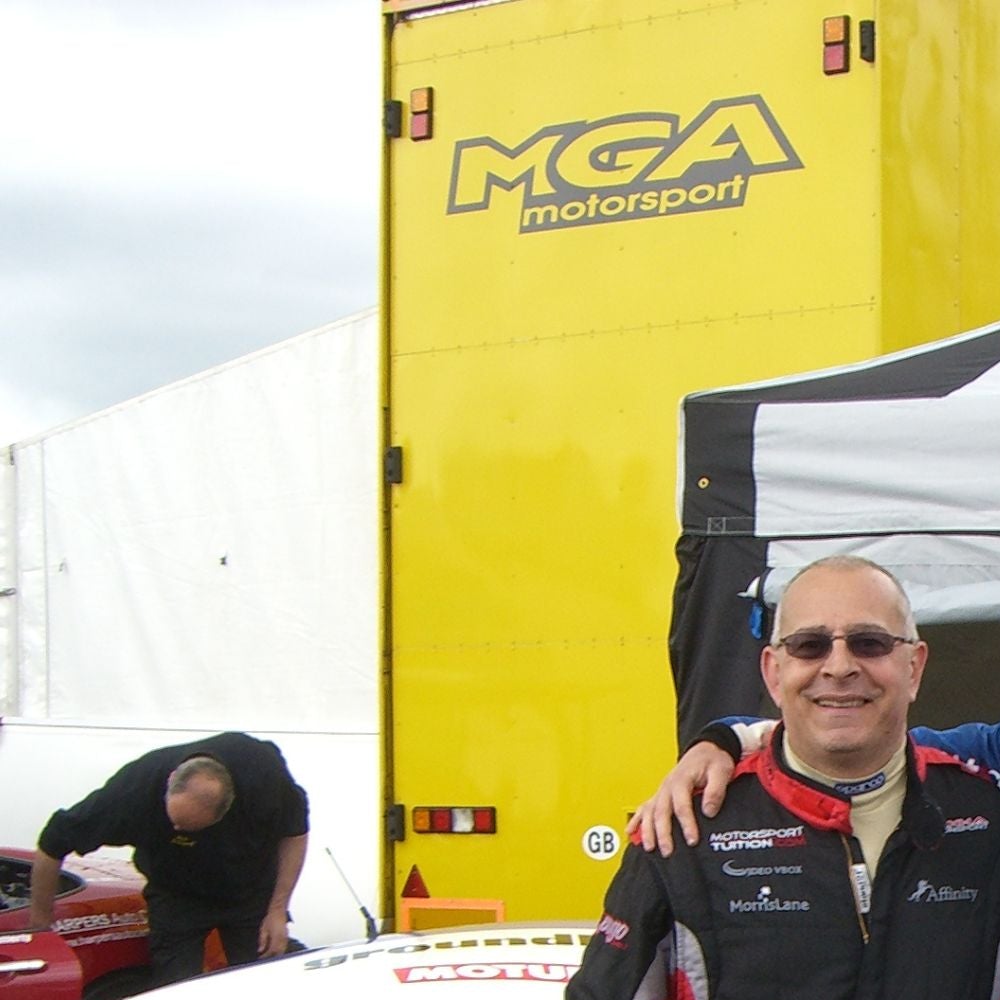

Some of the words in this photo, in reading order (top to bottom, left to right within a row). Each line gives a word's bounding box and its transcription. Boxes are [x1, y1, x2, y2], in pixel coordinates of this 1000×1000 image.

[446, 94, 804, 215] MGA
[521, 175, 744, 227] motorsport
[587, 831, 615, 853] GB
[709, 826, 805, 841] MOTORSPORT
[926, 885, 979, 903] Affinity
